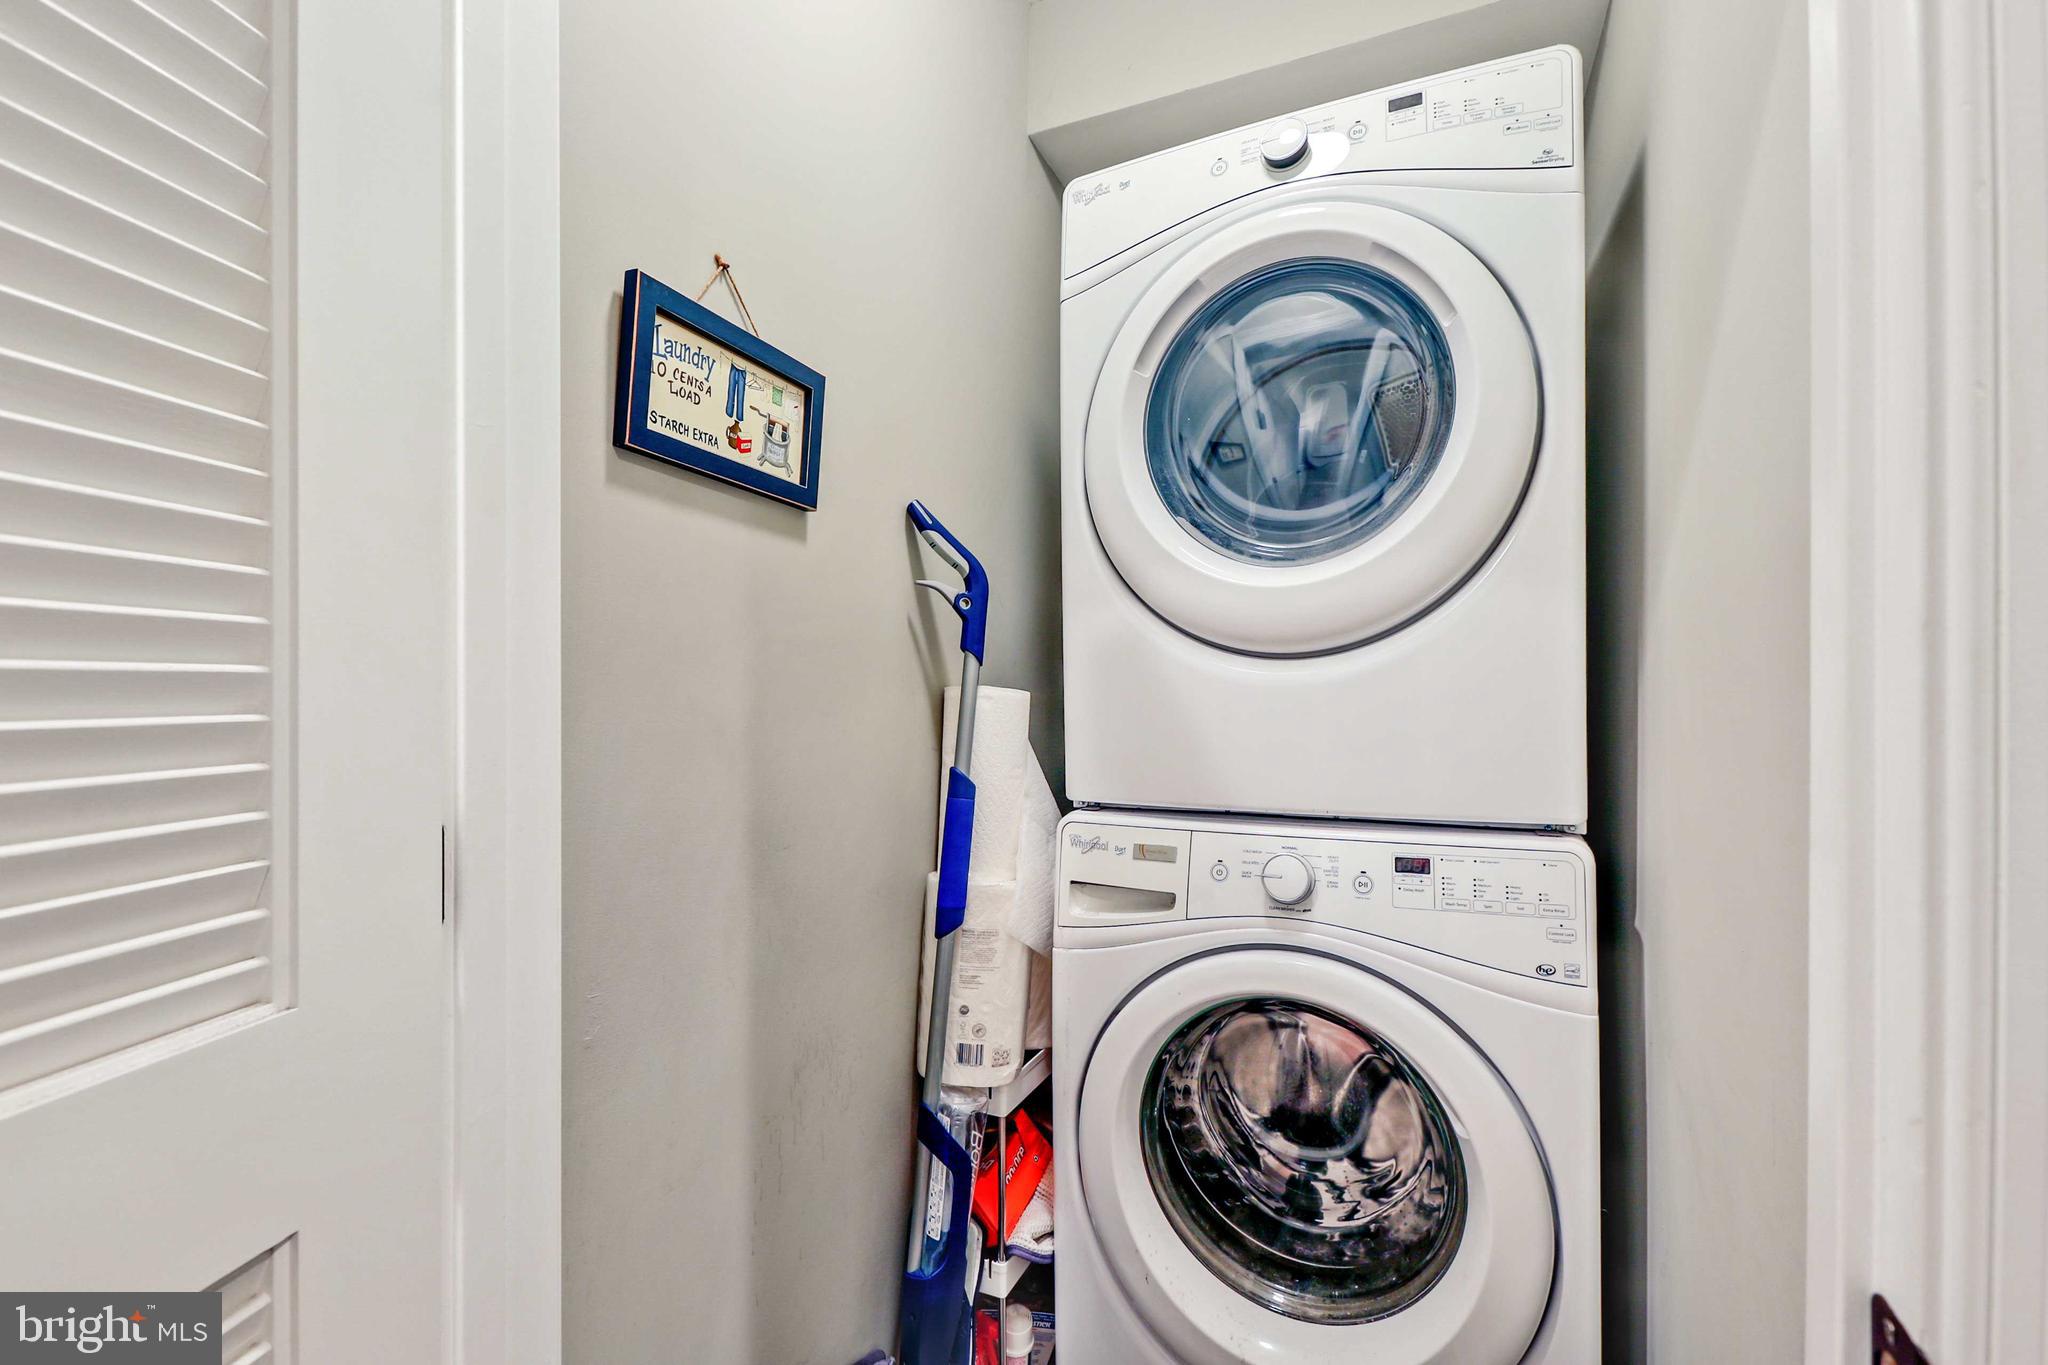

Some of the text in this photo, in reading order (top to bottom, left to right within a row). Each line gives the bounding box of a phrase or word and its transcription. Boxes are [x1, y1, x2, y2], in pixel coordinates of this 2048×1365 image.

[652, 323, 717, 381] Laundry
[668, 380, 701, 406] LOAD
[673, 367, 706, 392] CENTS
[705, 385, 713, 398] A
[649, 410, 720, 449] STARCH EXTRA
[1068, 833, 1109, 854] Whirlpool
